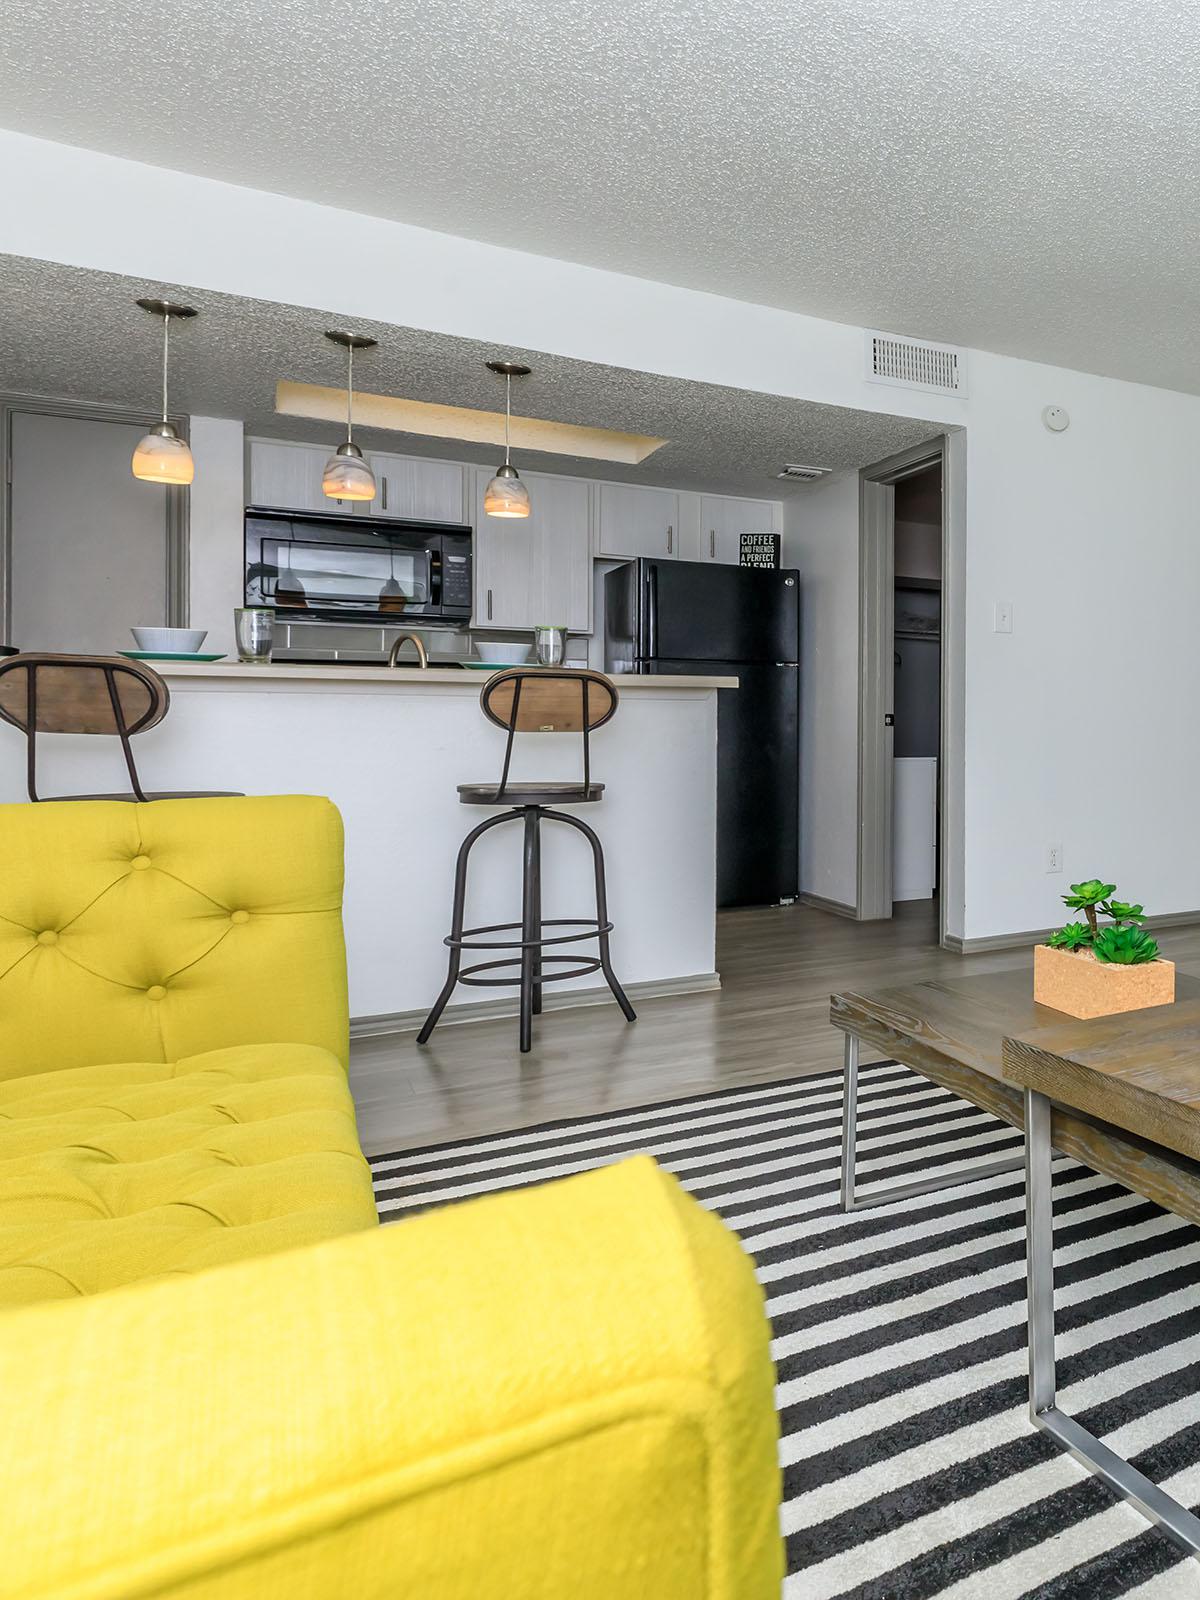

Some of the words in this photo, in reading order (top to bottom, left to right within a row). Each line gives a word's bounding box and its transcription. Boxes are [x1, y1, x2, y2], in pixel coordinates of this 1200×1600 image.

[741, 535, 774, 545] COFFEE
[741, 554, 746, 562] A
[747, 554, 774, 562] PERFECT
